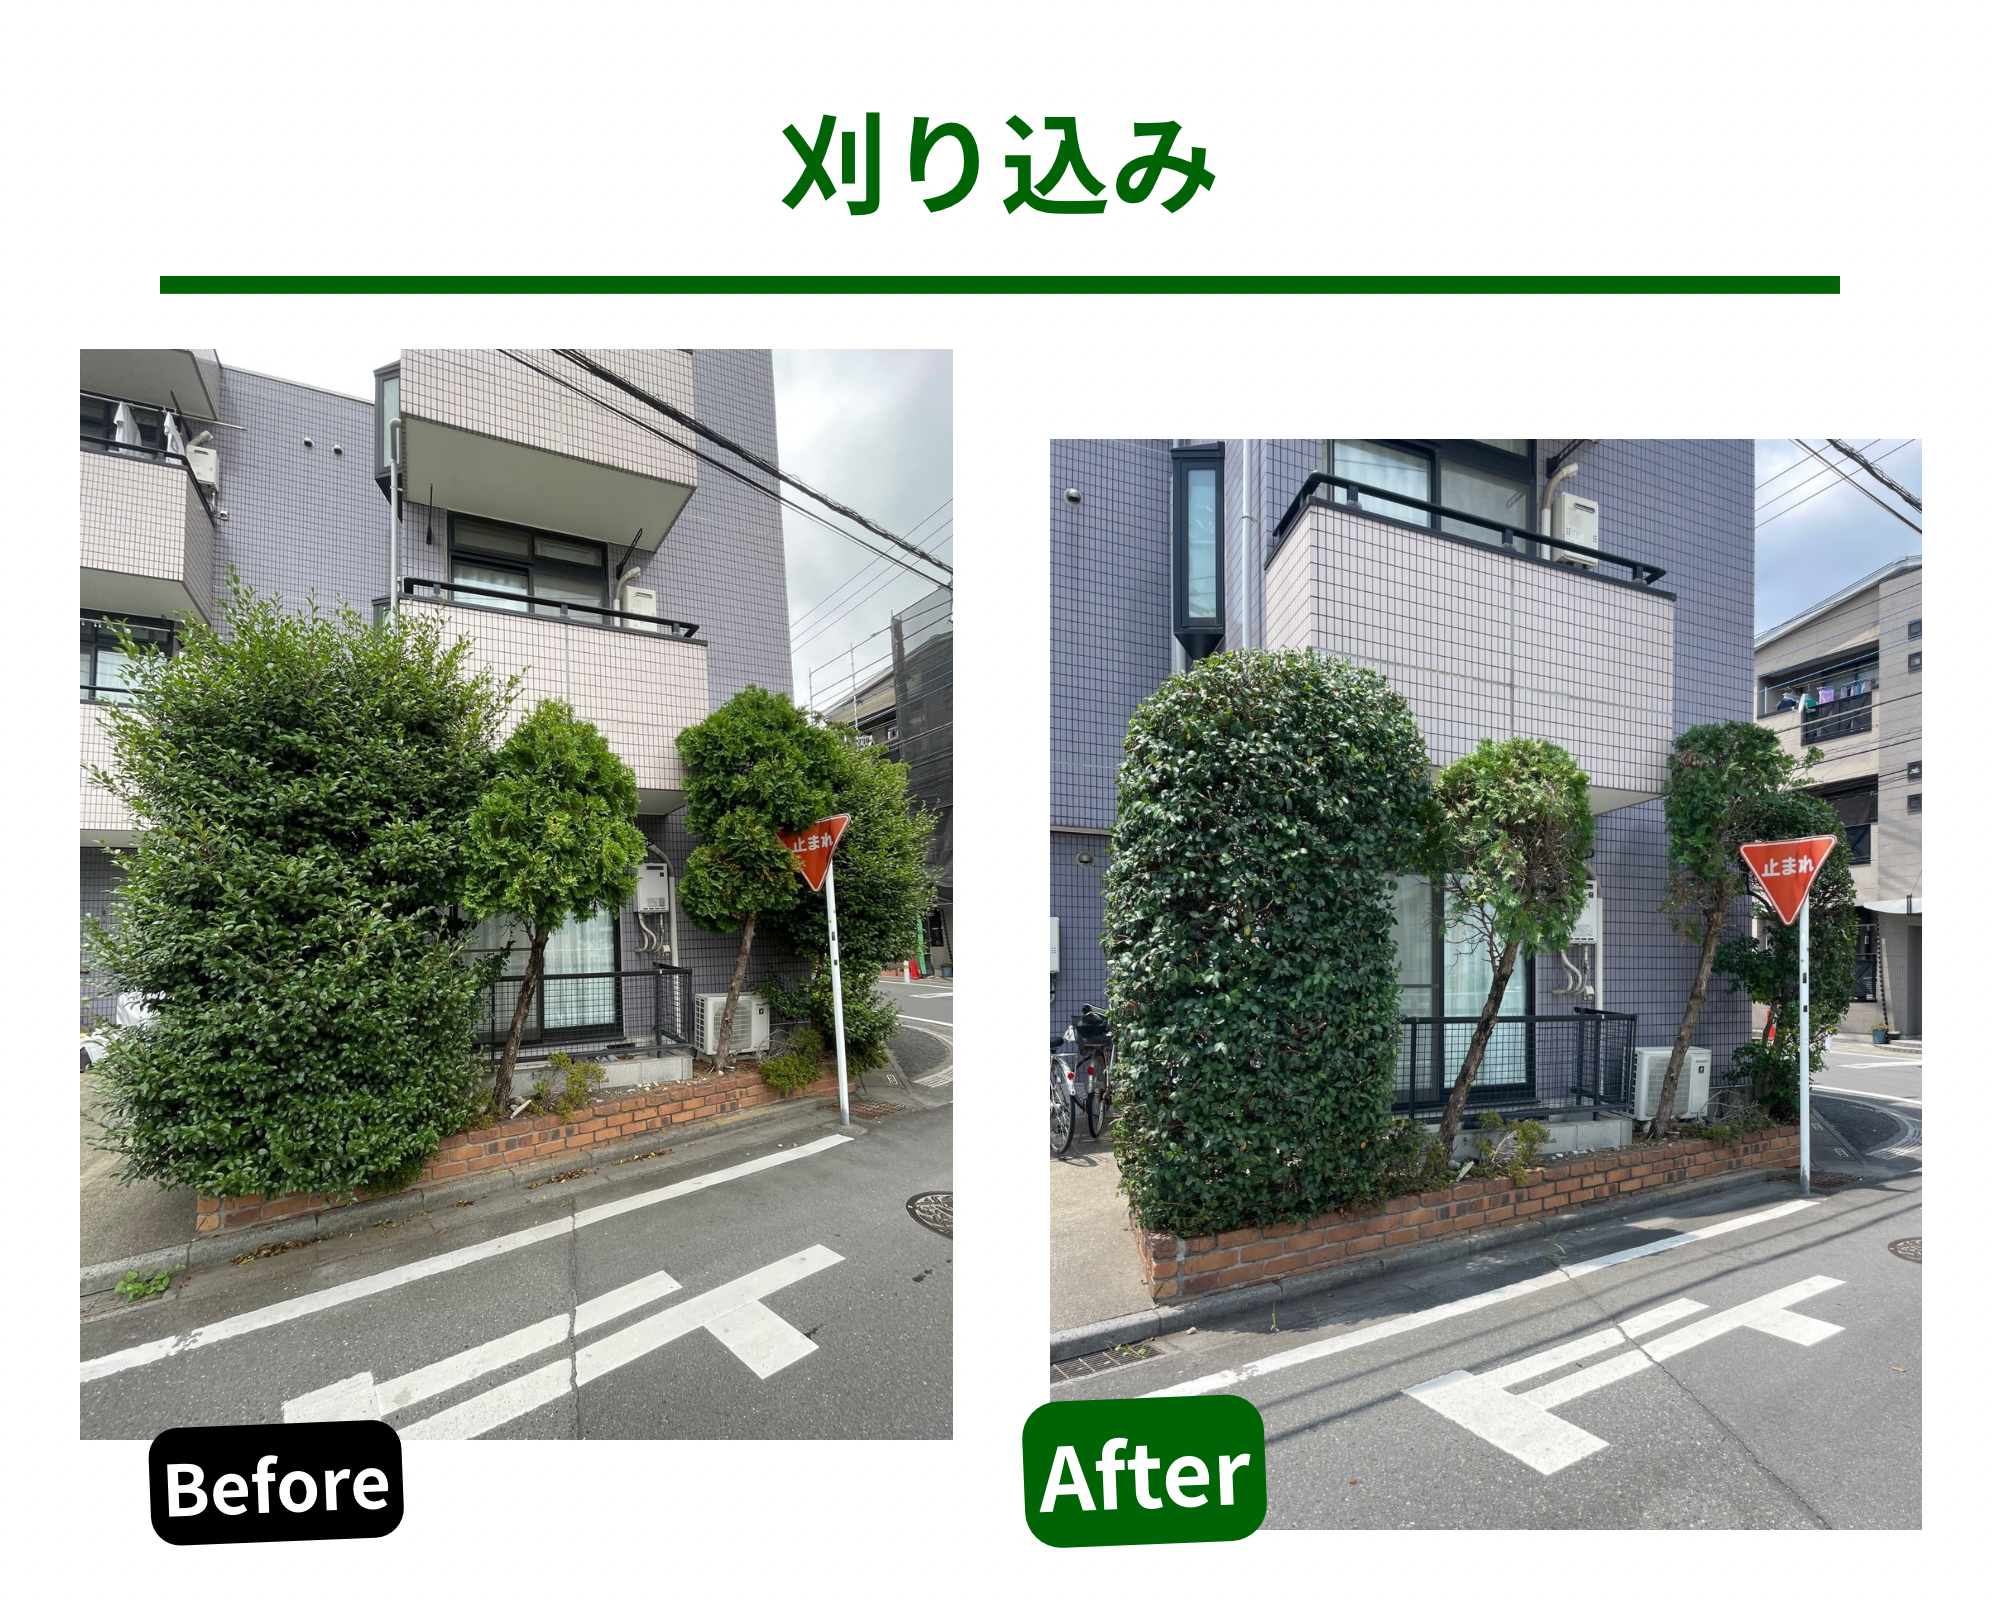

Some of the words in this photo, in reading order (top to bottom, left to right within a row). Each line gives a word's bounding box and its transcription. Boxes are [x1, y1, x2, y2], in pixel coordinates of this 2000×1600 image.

[792, 832, 834, 853] 止まれ
[1761, 855, 1815, 877] 止まれ
